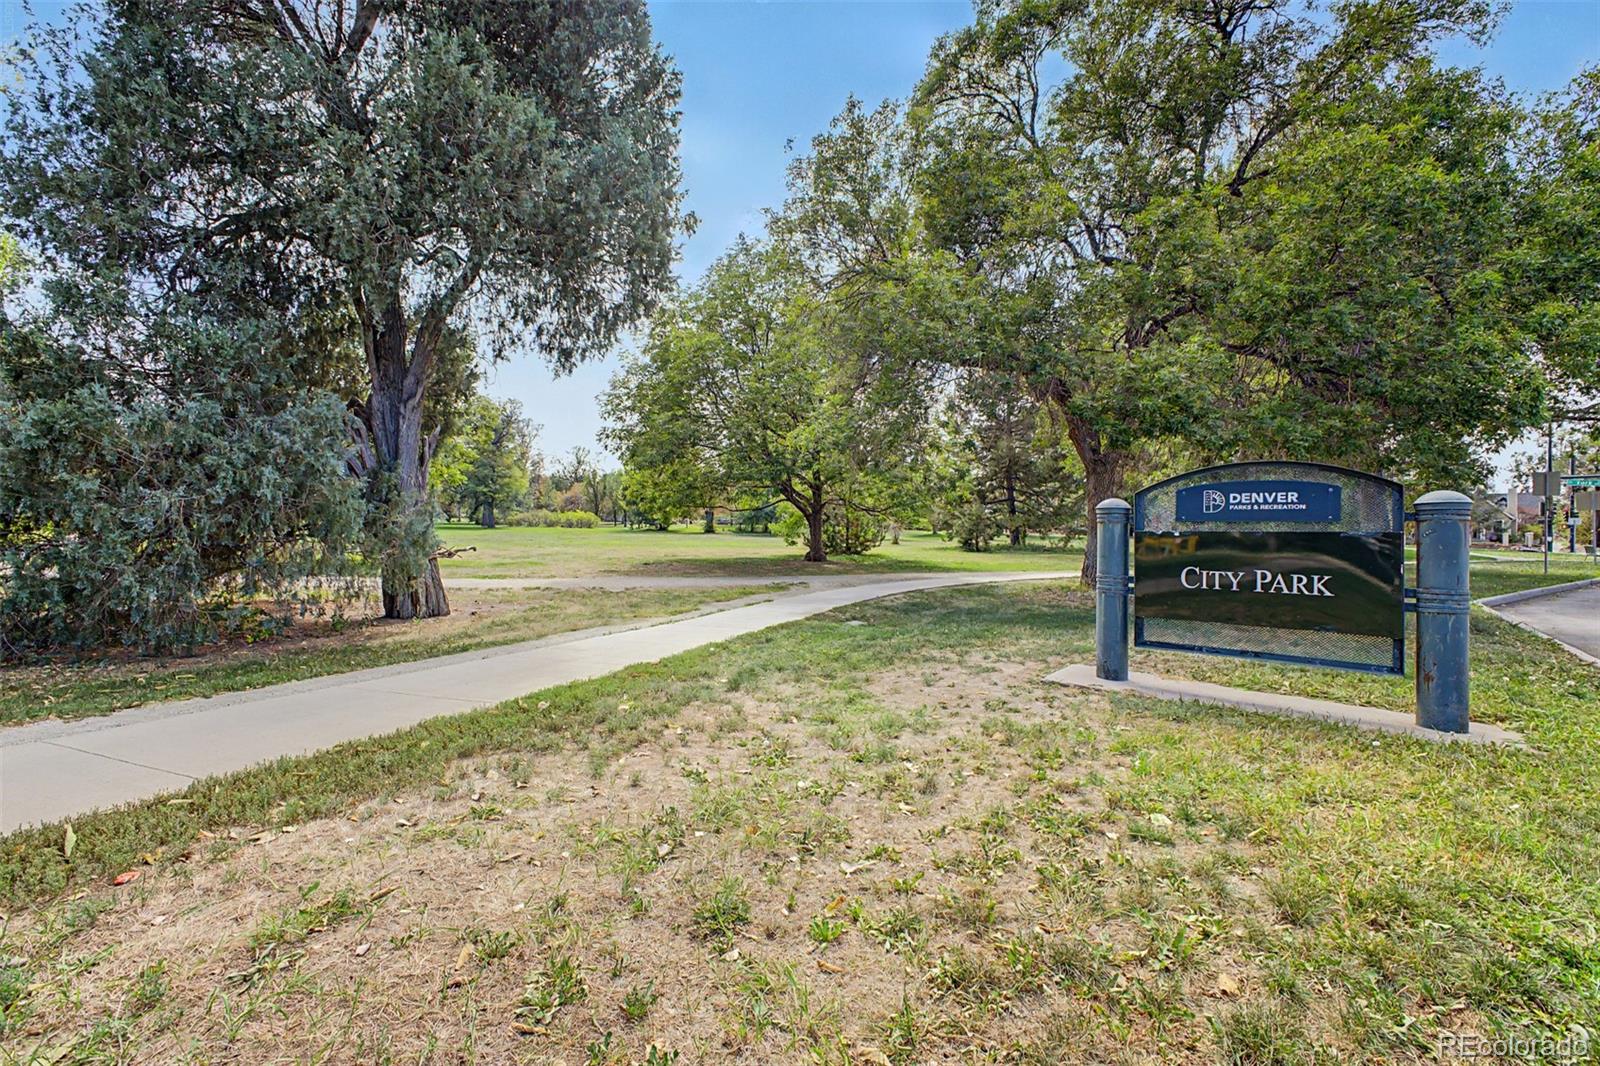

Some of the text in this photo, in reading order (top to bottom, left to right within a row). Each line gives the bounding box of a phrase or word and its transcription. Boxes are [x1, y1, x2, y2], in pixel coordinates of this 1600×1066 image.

[1229, 492, 1299, 503] DENVER
[1181, 566, 1335, 597] CITY PARK
